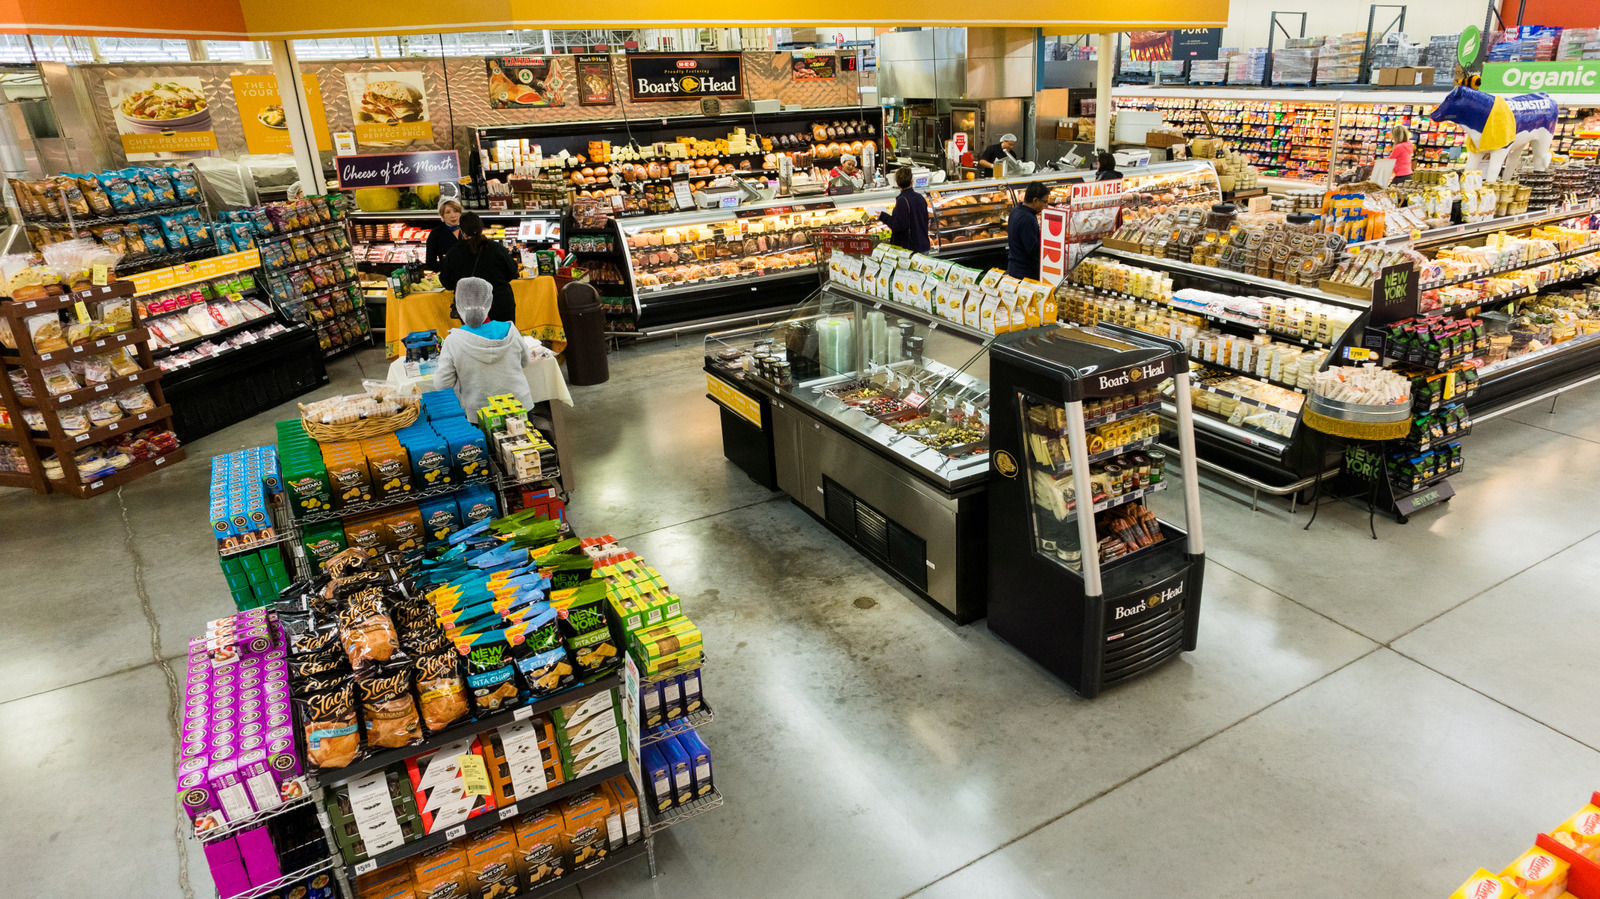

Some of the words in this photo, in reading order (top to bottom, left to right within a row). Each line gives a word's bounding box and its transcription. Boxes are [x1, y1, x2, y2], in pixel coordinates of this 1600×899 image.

[848, 58, 855, 70] 0
[637, 77, 680, 94] Boar's
[699, 76, 737, 92] Head
[1501, 65, 1598, 90] Organic
[240, 89, 274, 97] YOUR
[128, 136, 210, 146] CHEF-PREPARED
[402, 130, 426, 138] PRICE
[343, 164, 378, 181] Cheese
[380, 161, 391, 185] of
[392, 160, 411, 176] the
[413, 155, 454, 173] Month
[1072, 182, 1122, 199] PRIMIZIE
[1384, 268, 1409, 288] NEW
[1384, 283, 1407, 301] YORK
[1384, 297, 1406, 307] STYLE
[1099, 371, 1130, 390] Boar's
[1142, 361, 1165, 379] Head
[379, 462, 401, 473] WHEAT
[1345, 456, 1380, 480] YORK
[337, 471, 361, 482] WHEAT
[293, 480, 324, 493] VEGETABLE
[355, 532, 378, 544] WHEAT
[394, 524, 415, 535] WHEAT
[311, 541, 341, 555] VEGETABLE
[552, 572, 580, 583] NEW
[1114, 599, 1147, 620] Boar's
[1160, 580, 1184, 604] Head
[568, 605, 599, 623] NEW
[571, 615, 602, 632] YORK
[526, 625, 555, 645] NEW
[574, 637, 591, 648] PITA
[590, 630, 611, 644] CHIPS
[470, 645, 503, 661] NEW
[416, 646, 458, 683] Stacy's
[529, 659, 546, 670] PITA
[360, 670, 407, 701] Stacy's
[472, 678, 489, 687] PITA
[490, 671, 511, 684] CHIPS
[307, 683, 355, 720] Stacy's
[571, 835, 584, 845] WHEAT
[583, 828, 599, 839] CRISP
[524, 851, 540, 862] WHEAT
[539, 843, 554, 855] CRISP
[477, 870, 494, 881] WHEAT
[493, 863, 508, 873] CRISP
